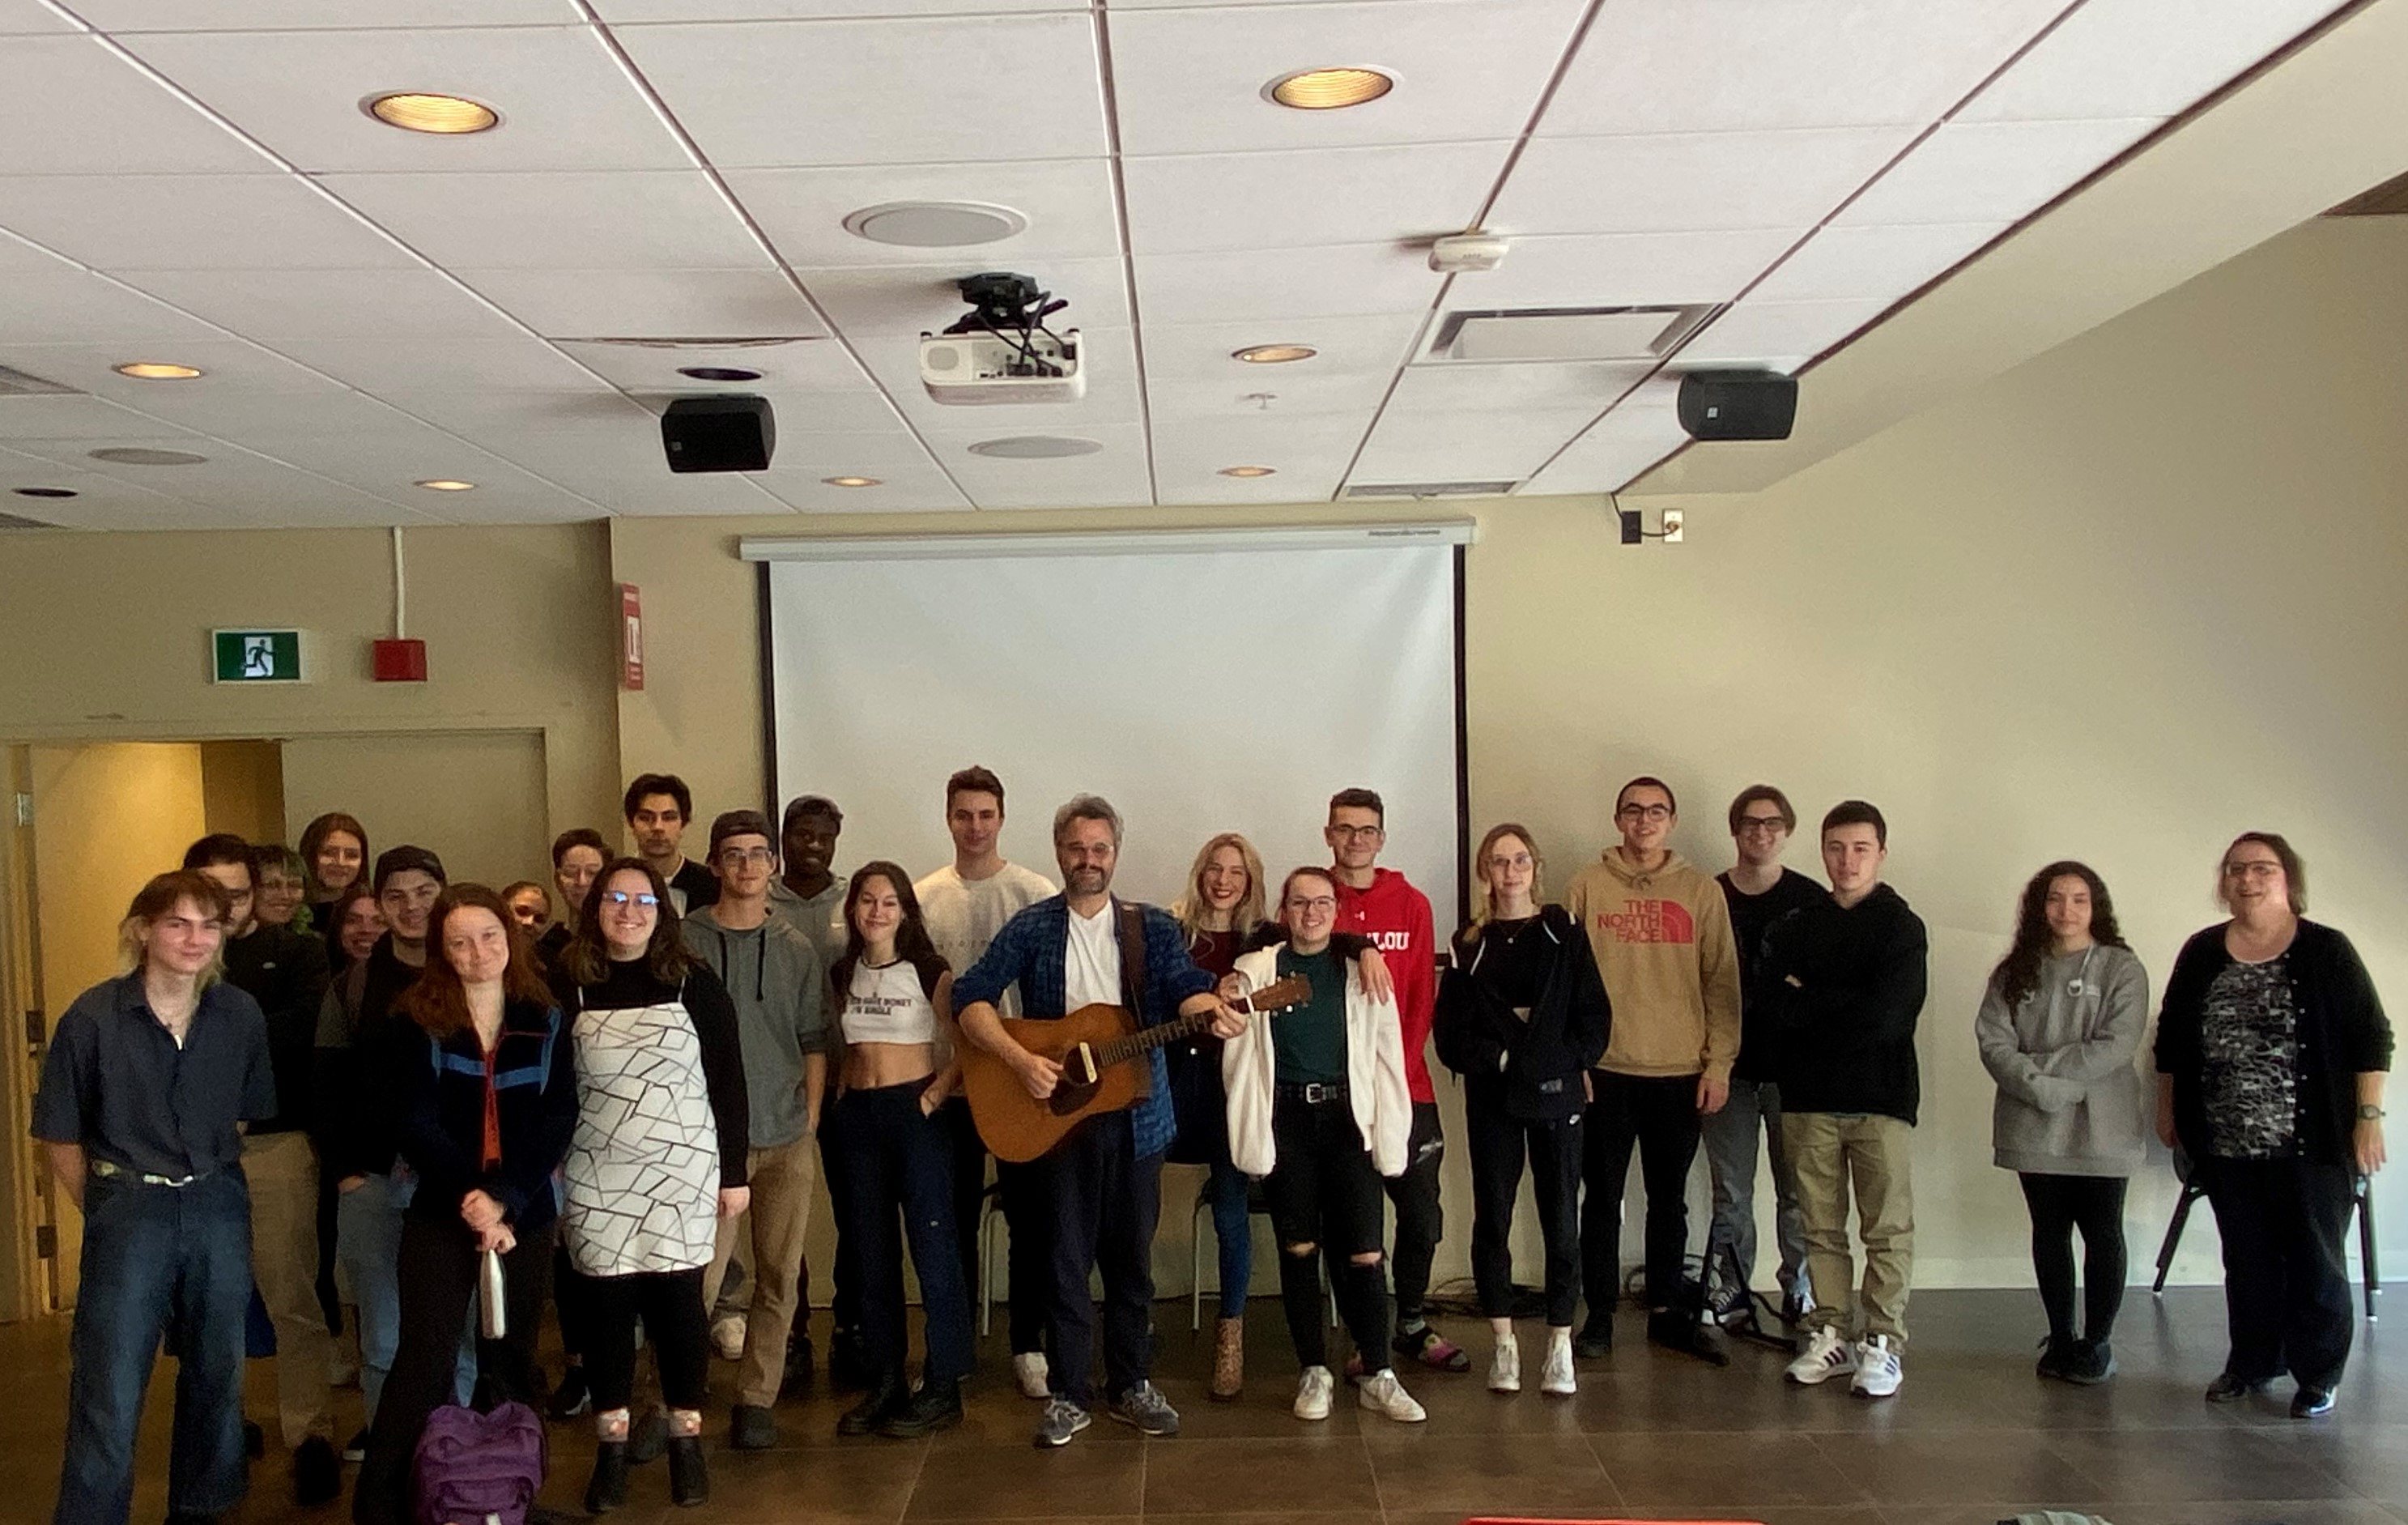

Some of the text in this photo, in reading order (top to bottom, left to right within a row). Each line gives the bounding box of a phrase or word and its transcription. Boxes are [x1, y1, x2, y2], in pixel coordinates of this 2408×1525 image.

[1623, 899, 1660, 914] THE
[1598, 914, 1660, 929] NORTH
[1616, 929, 1660, 944] FACE
